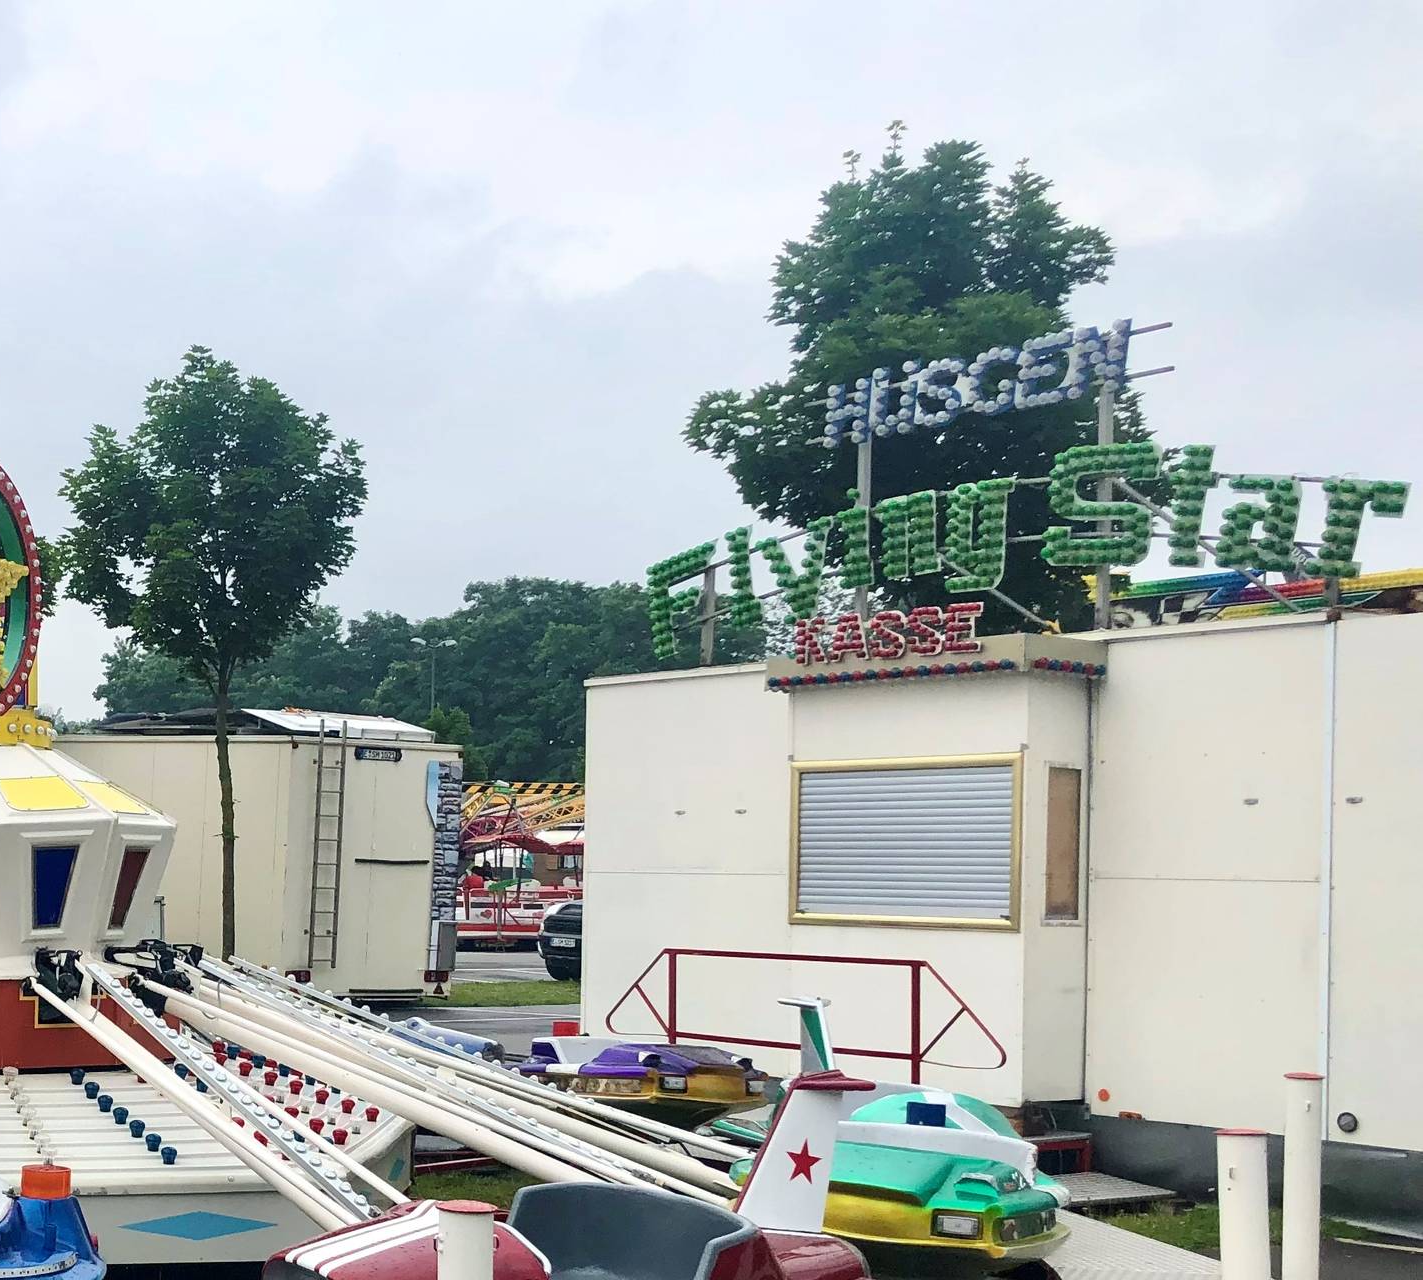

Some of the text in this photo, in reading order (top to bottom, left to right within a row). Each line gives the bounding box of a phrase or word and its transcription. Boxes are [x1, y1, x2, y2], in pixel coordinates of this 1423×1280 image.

[646, 441, 1412, 661] Flying Star
[795, 602, 984, 665] KASSE
